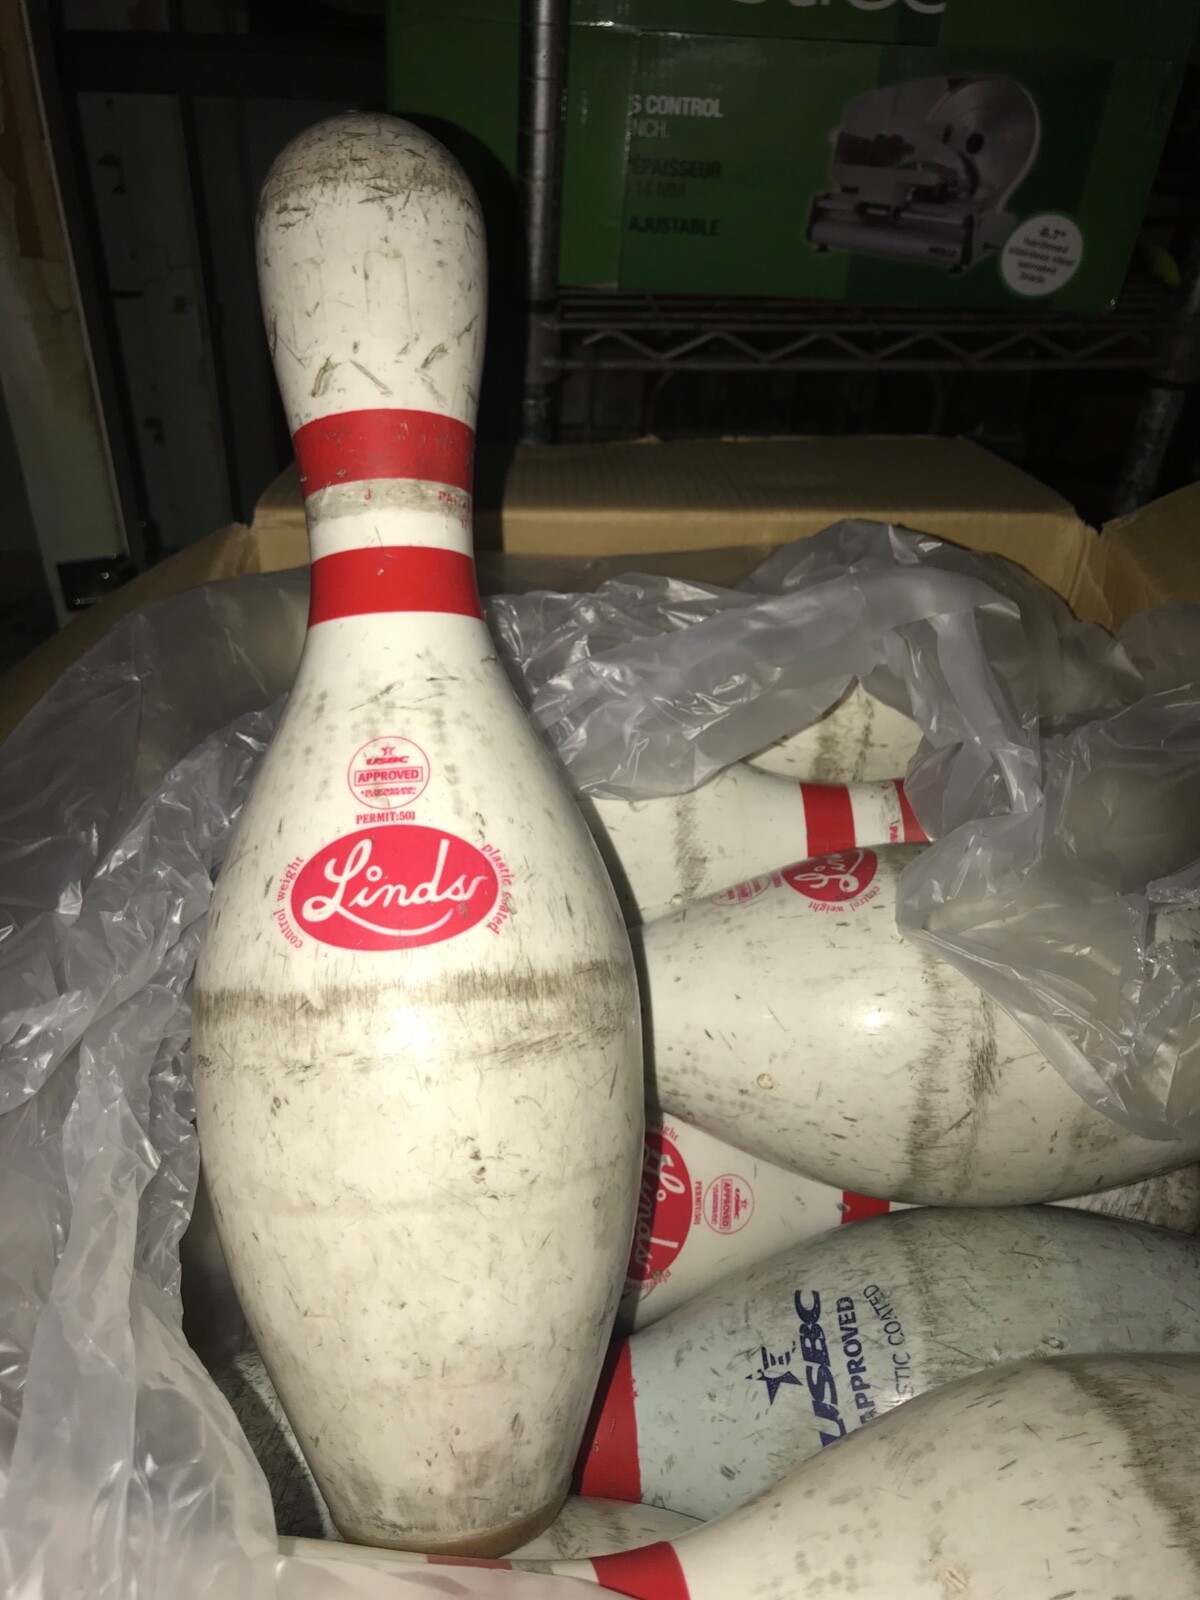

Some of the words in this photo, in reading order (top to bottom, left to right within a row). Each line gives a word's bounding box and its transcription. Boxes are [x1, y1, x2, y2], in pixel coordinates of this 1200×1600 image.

[645, 95, 724, 118] CONTROL
[629, 216, 720, 236] AJUSTABLE
[358, 769, 419, 783] APPROVED
[356, 811, 416, 825] PERMIT:501
[277, 856, 304, 901] weight
[481, 842, 512, 886] plastic
[301, 838, 488, 937] Linds
[808, 901, 844, 914] weight
[850, 886, 880, 912] control
[273, 908, 303, 949] control
[722, 1181, 731, 1229] APPROVED
[863, 1284, 905, 1346] COATED
[795, 1290, 847, 1447] USBC
[836, 1296, 879, 1425] APPROVED
[892, 1351, 914, 1397] STIC
